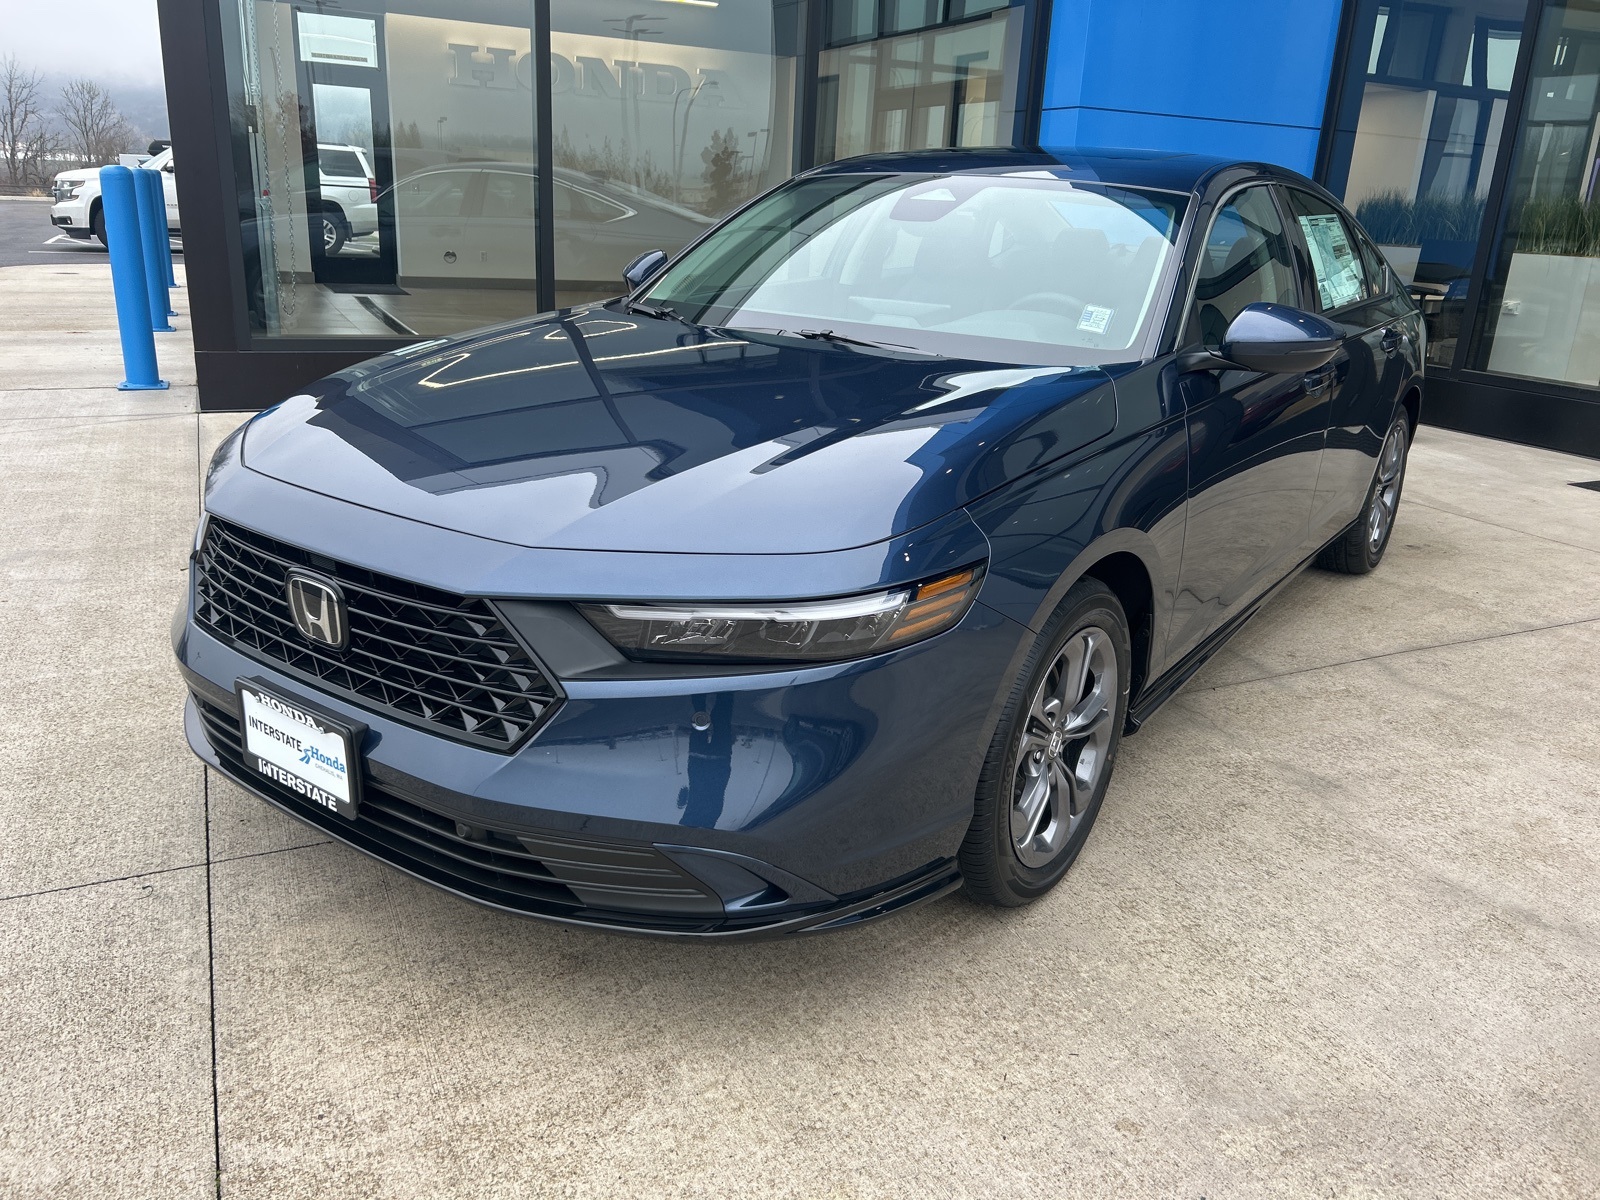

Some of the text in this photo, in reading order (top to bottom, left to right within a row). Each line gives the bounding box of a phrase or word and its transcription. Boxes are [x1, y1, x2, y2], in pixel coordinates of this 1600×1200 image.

[448, 43, 745, 109] HONDA
[258, 693, 318, 731] HONDA
[248, 715, 302, 753] INTERSTATE
[310, 745, 346, 773] Honda
[258, 758, 338, 812] INTERSTATE
